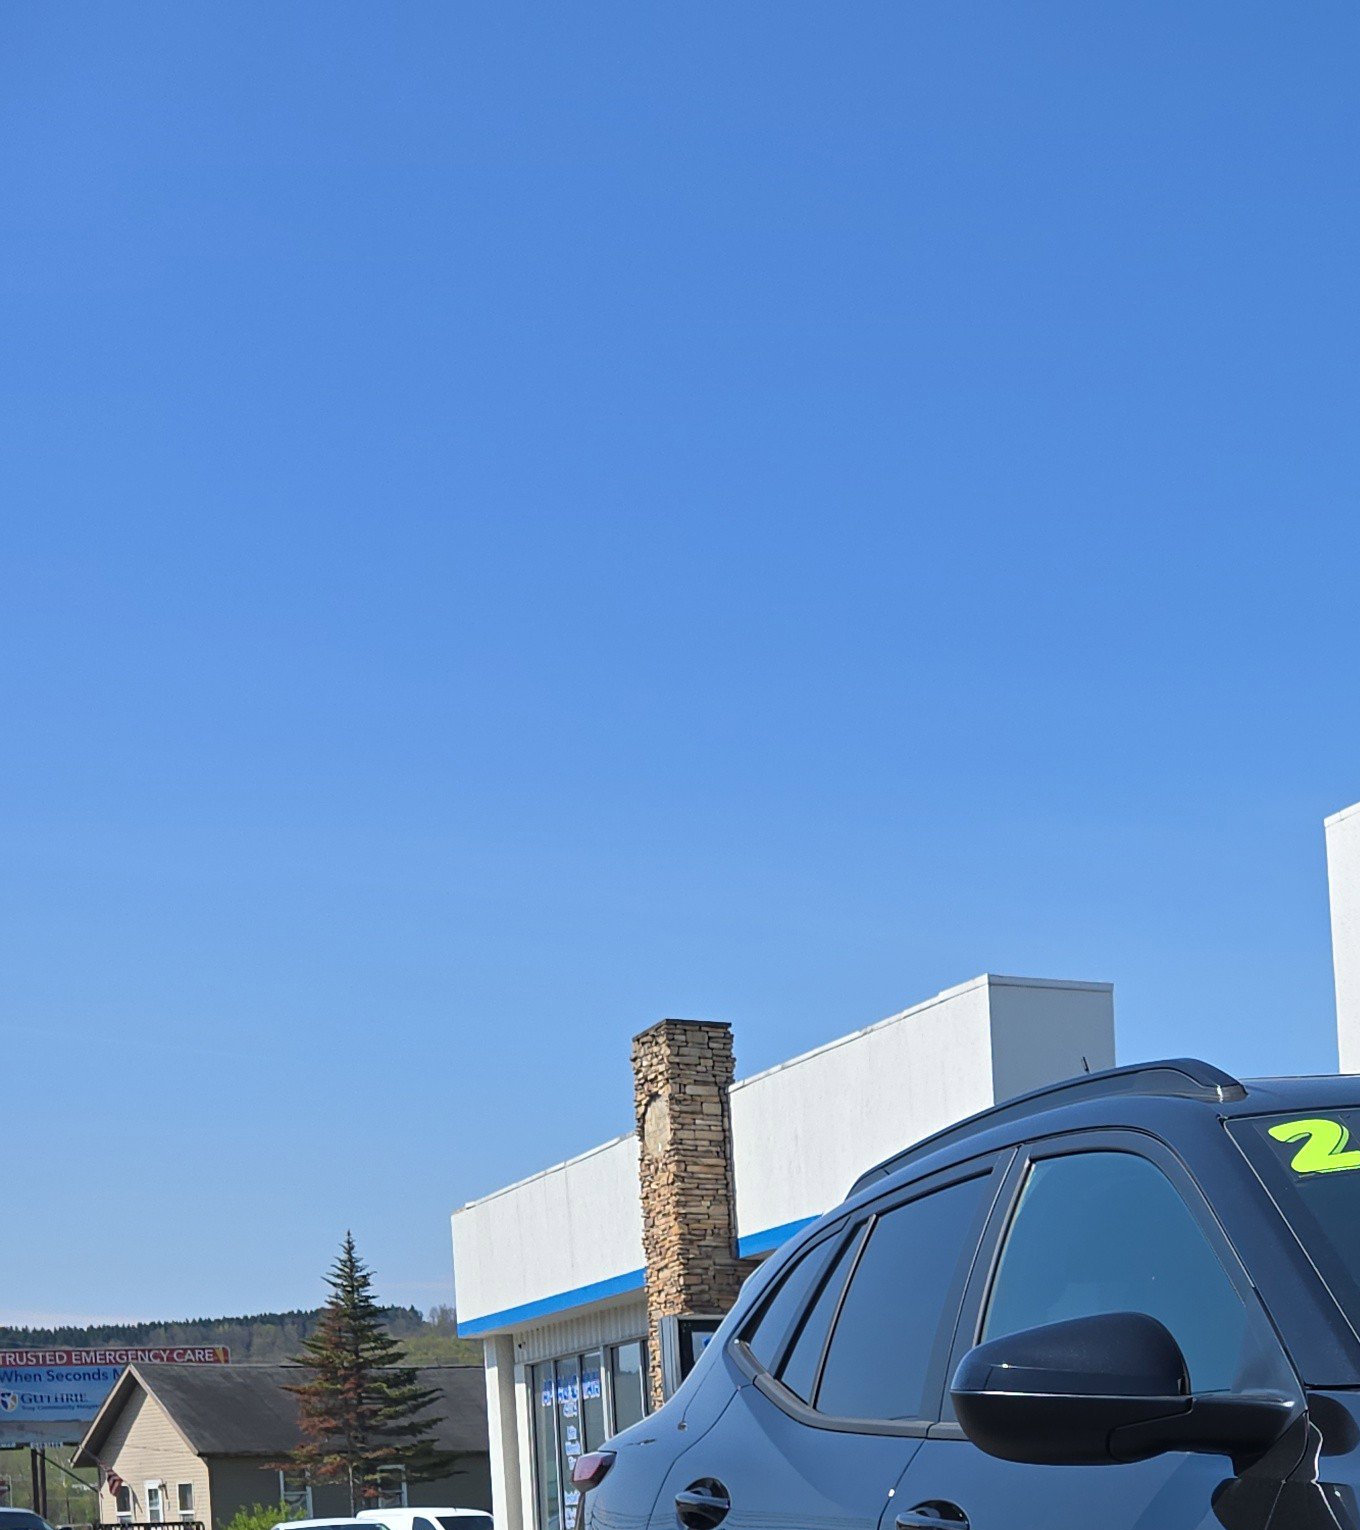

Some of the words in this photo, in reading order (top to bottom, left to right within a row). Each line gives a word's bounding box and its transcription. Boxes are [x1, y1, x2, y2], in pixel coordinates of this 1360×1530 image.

[0, 1351, 67, 1366] TRUSTED
[72, 1350, 169, 1364] EMERGENCY
[173, 1349, 214, 1362] CARE
[0, 1370, 42, 1384] When
[46, 1368, 109, 1382] Seconds
